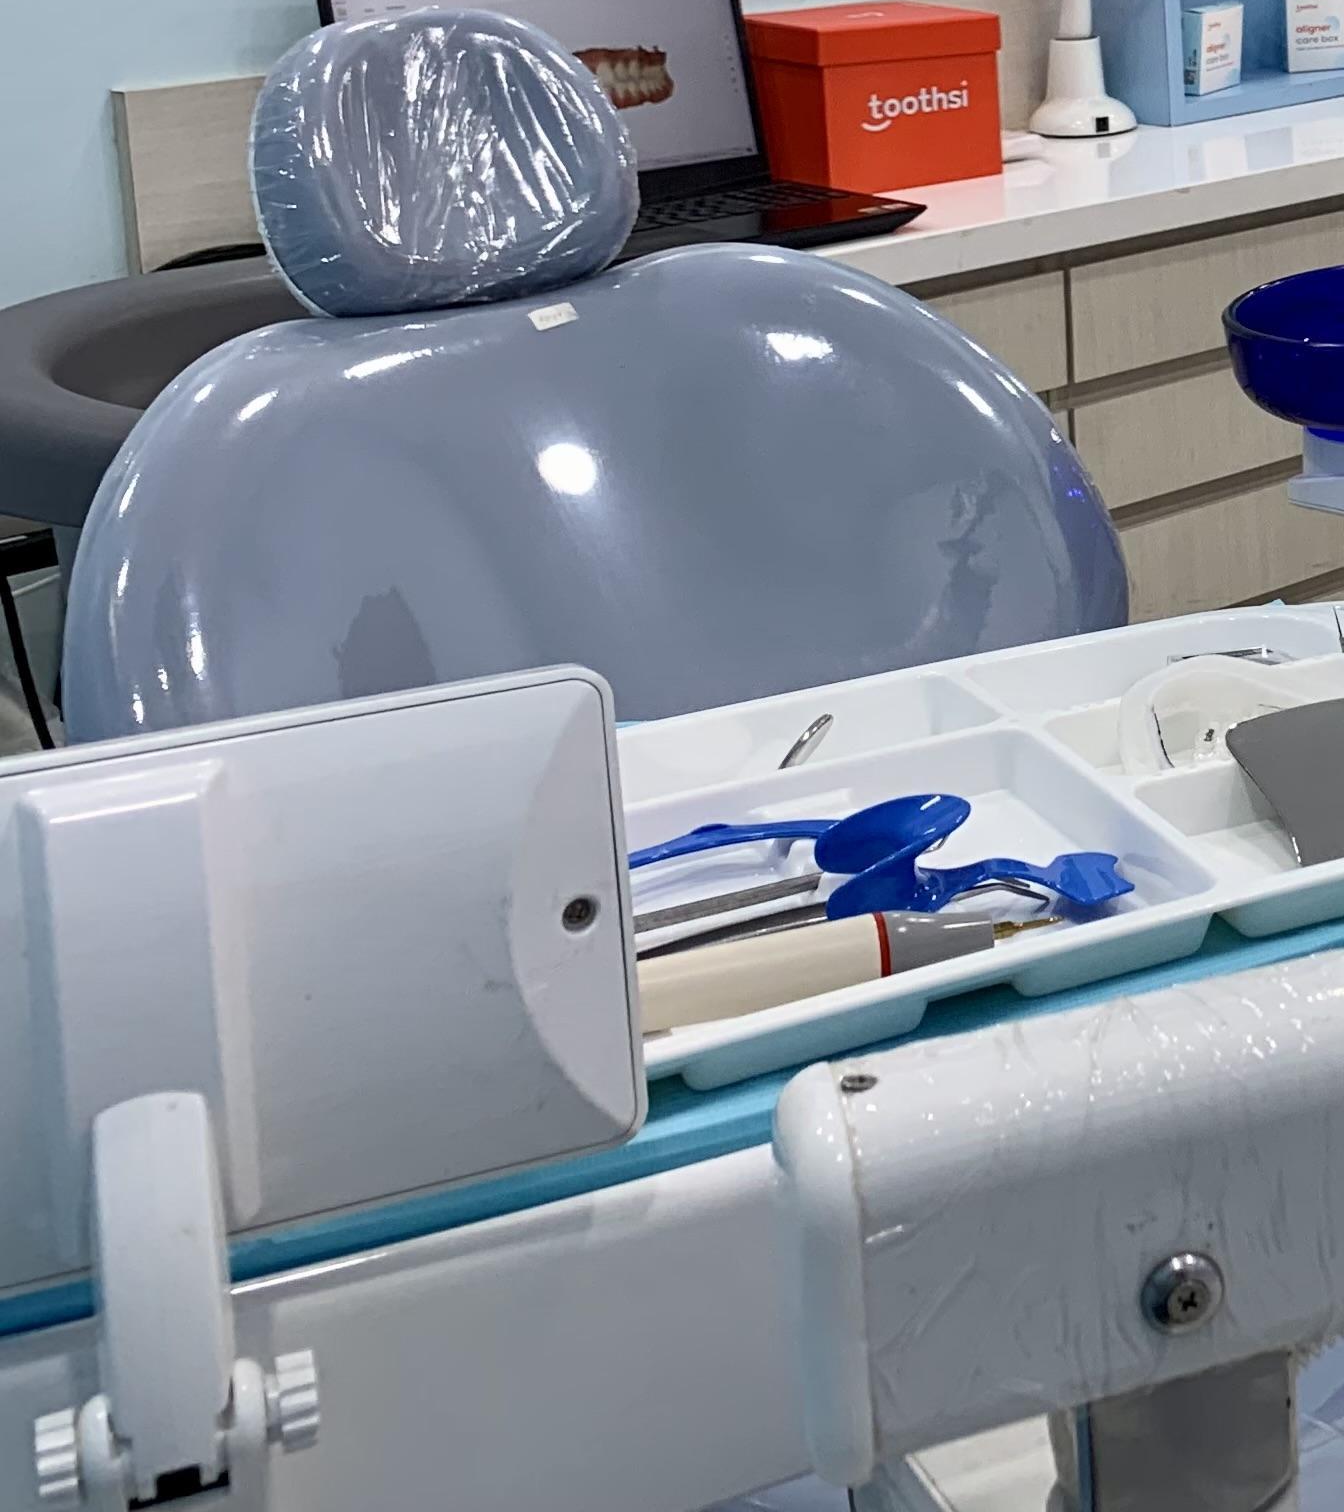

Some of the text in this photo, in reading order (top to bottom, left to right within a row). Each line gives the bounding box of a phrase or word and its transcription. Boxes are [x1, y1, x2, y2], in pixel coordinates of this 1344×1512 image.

[1295, 24, 1331, 35] aligner
[1295, 36, 1320, 45] care
[865, 80, 969, 122] toothsi
